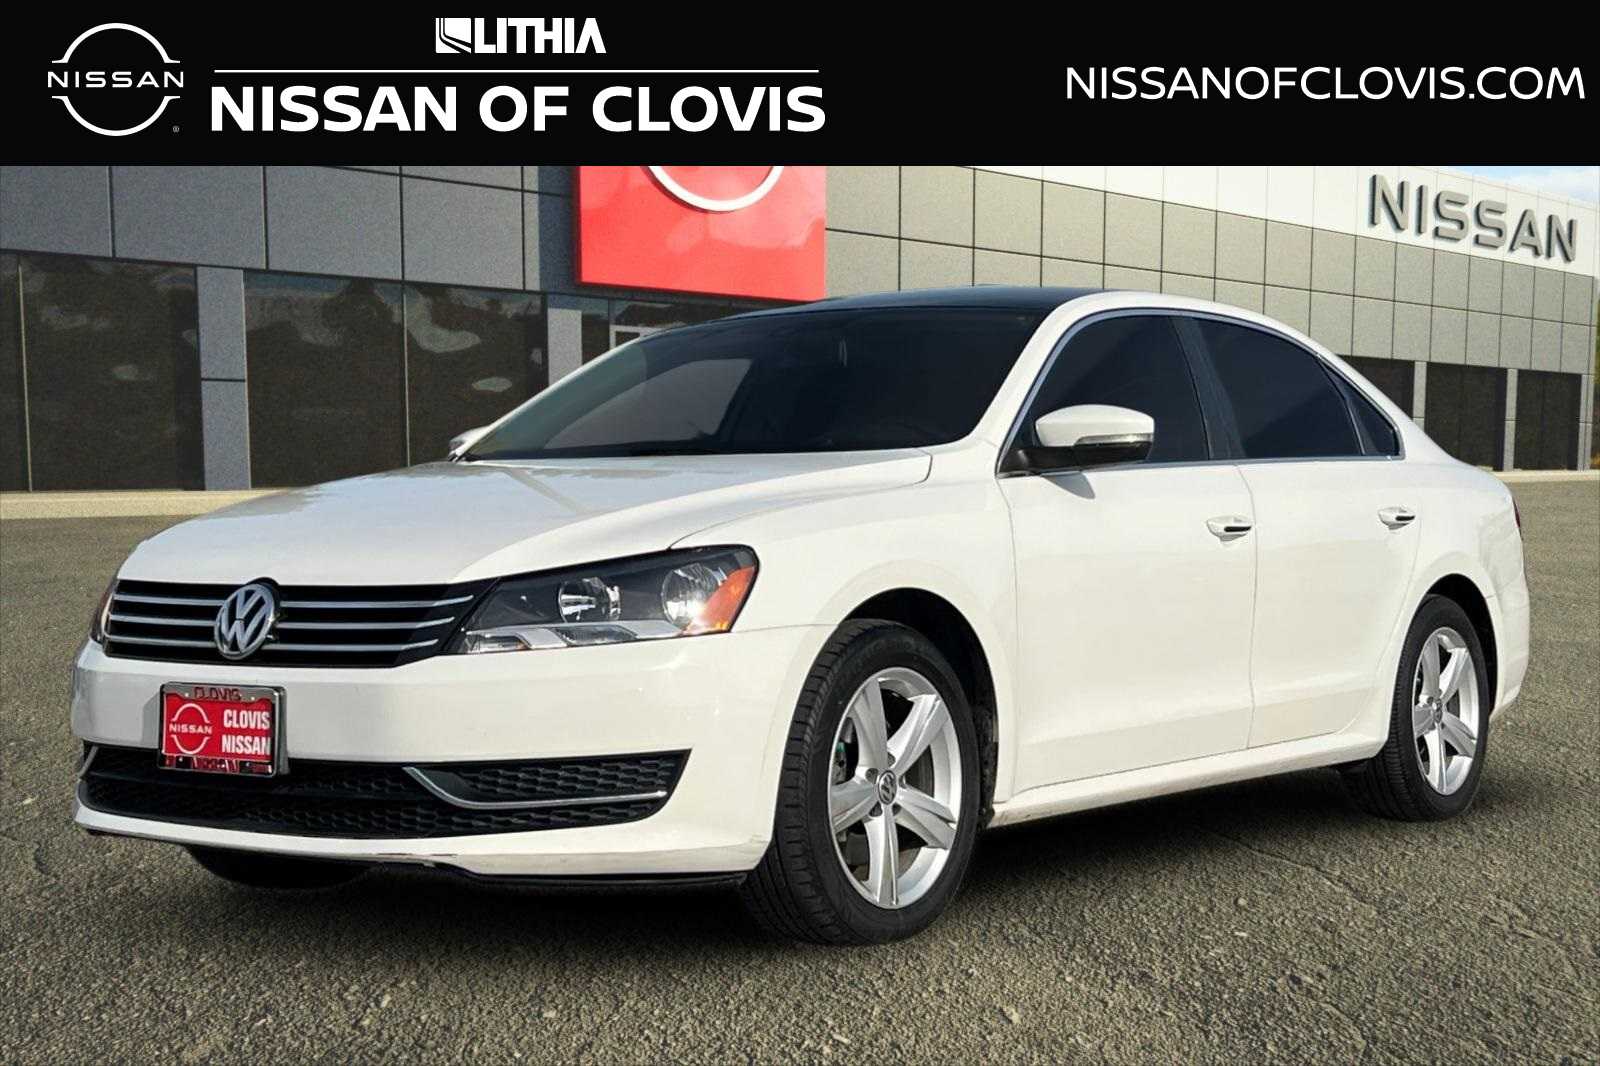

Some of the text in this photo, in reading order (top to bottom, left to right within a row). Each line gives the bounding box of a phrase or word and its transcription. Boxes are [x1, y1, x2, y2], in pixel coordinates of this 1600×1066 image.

[1369, 174, 1578, 263] NISSAN
[169, 723, 212, 734] NISSAN
[223, 709, 270, 730] CLOVIS
[221, 734, 271, 755] NISSAN
